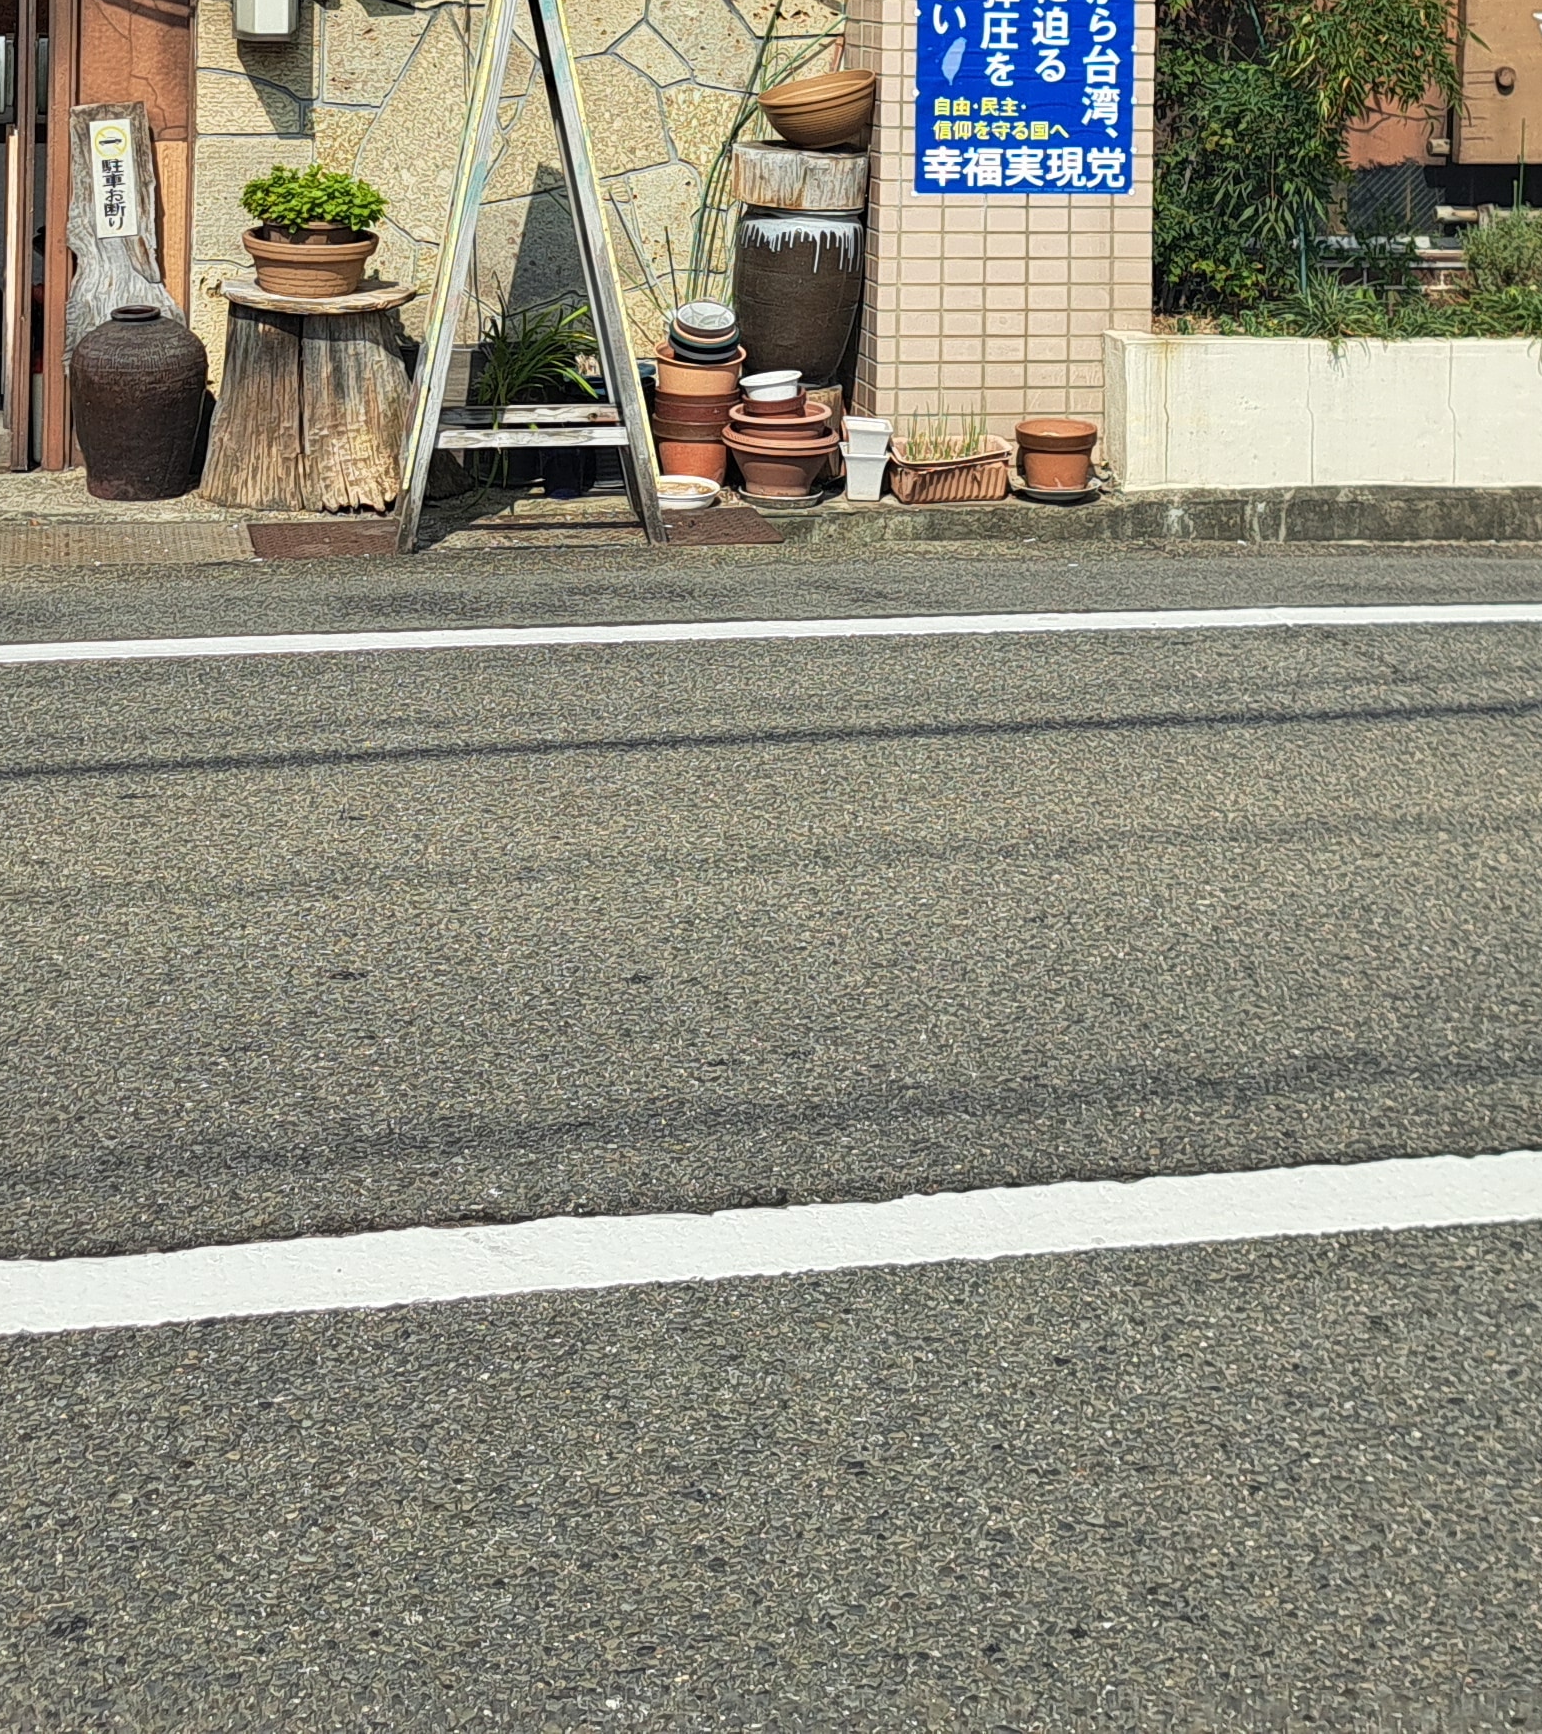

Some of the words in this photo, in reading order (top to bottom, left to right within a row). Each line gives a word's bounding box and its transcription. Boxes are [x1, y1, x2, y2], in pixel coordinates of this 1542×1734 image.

[933, 120, 1069, 141] 信仰を守る国へ
[922, 146, 1126, 188] 幸福実現党
[101, 158, 126, 230] 駐車お断り
